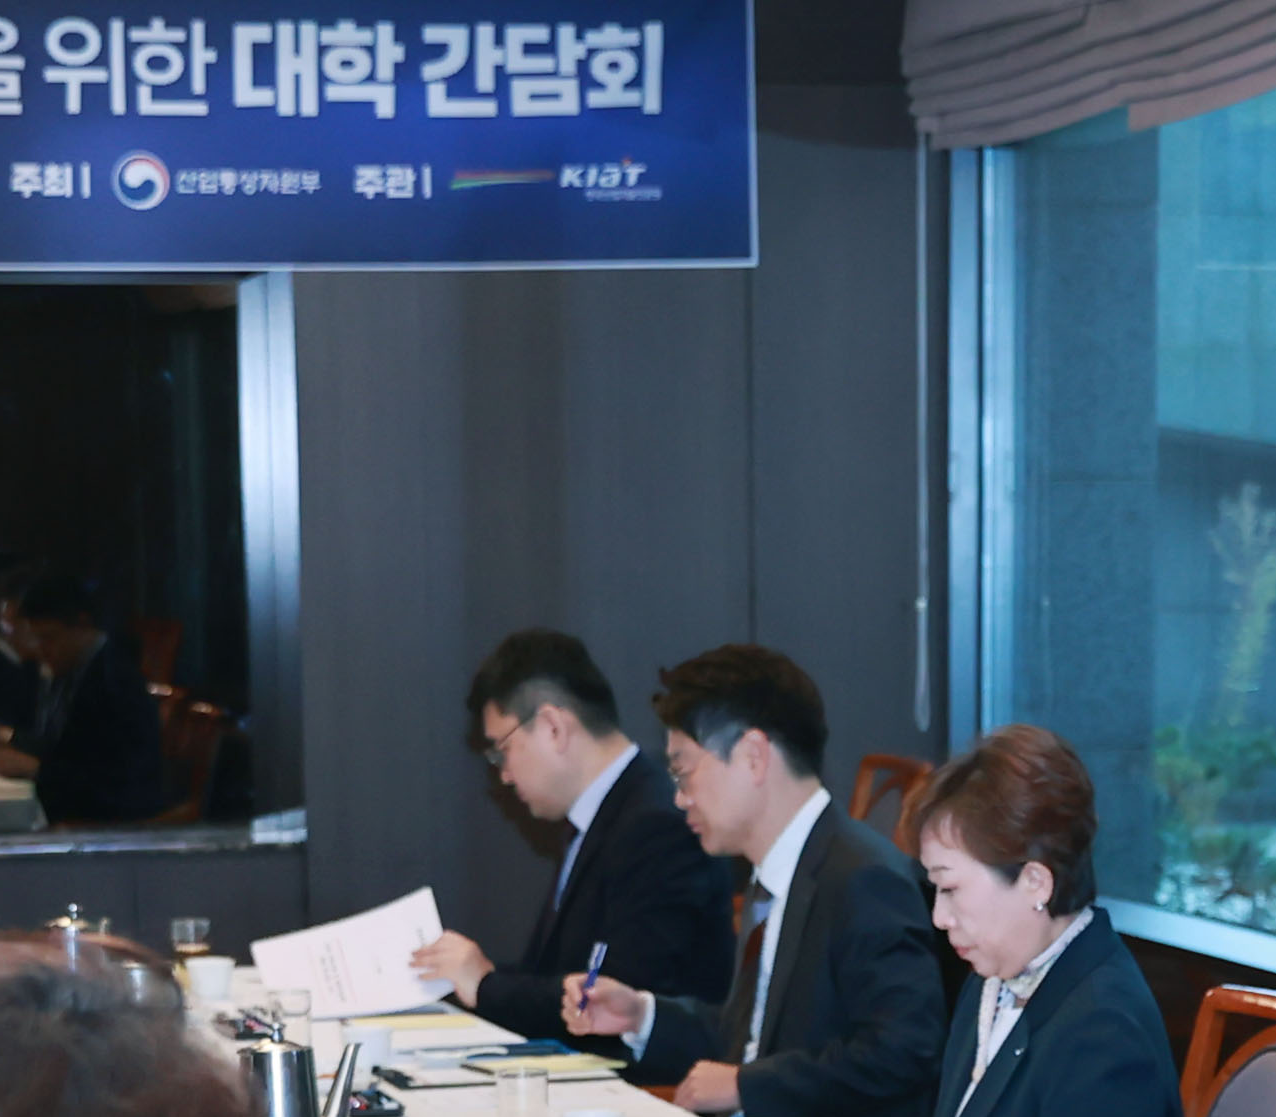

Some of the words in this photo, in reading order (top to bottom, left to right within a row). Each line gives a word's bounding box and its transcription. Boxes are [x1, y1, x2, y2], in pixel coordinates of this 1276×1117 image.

[43, 18, 217, 116] 위한
[233, 20, 405, 119] 대학
[421, 23, 662, 117] 간담회
[10, 162, 74, 198] 주최
[353, 164, 417, 199] 주관
